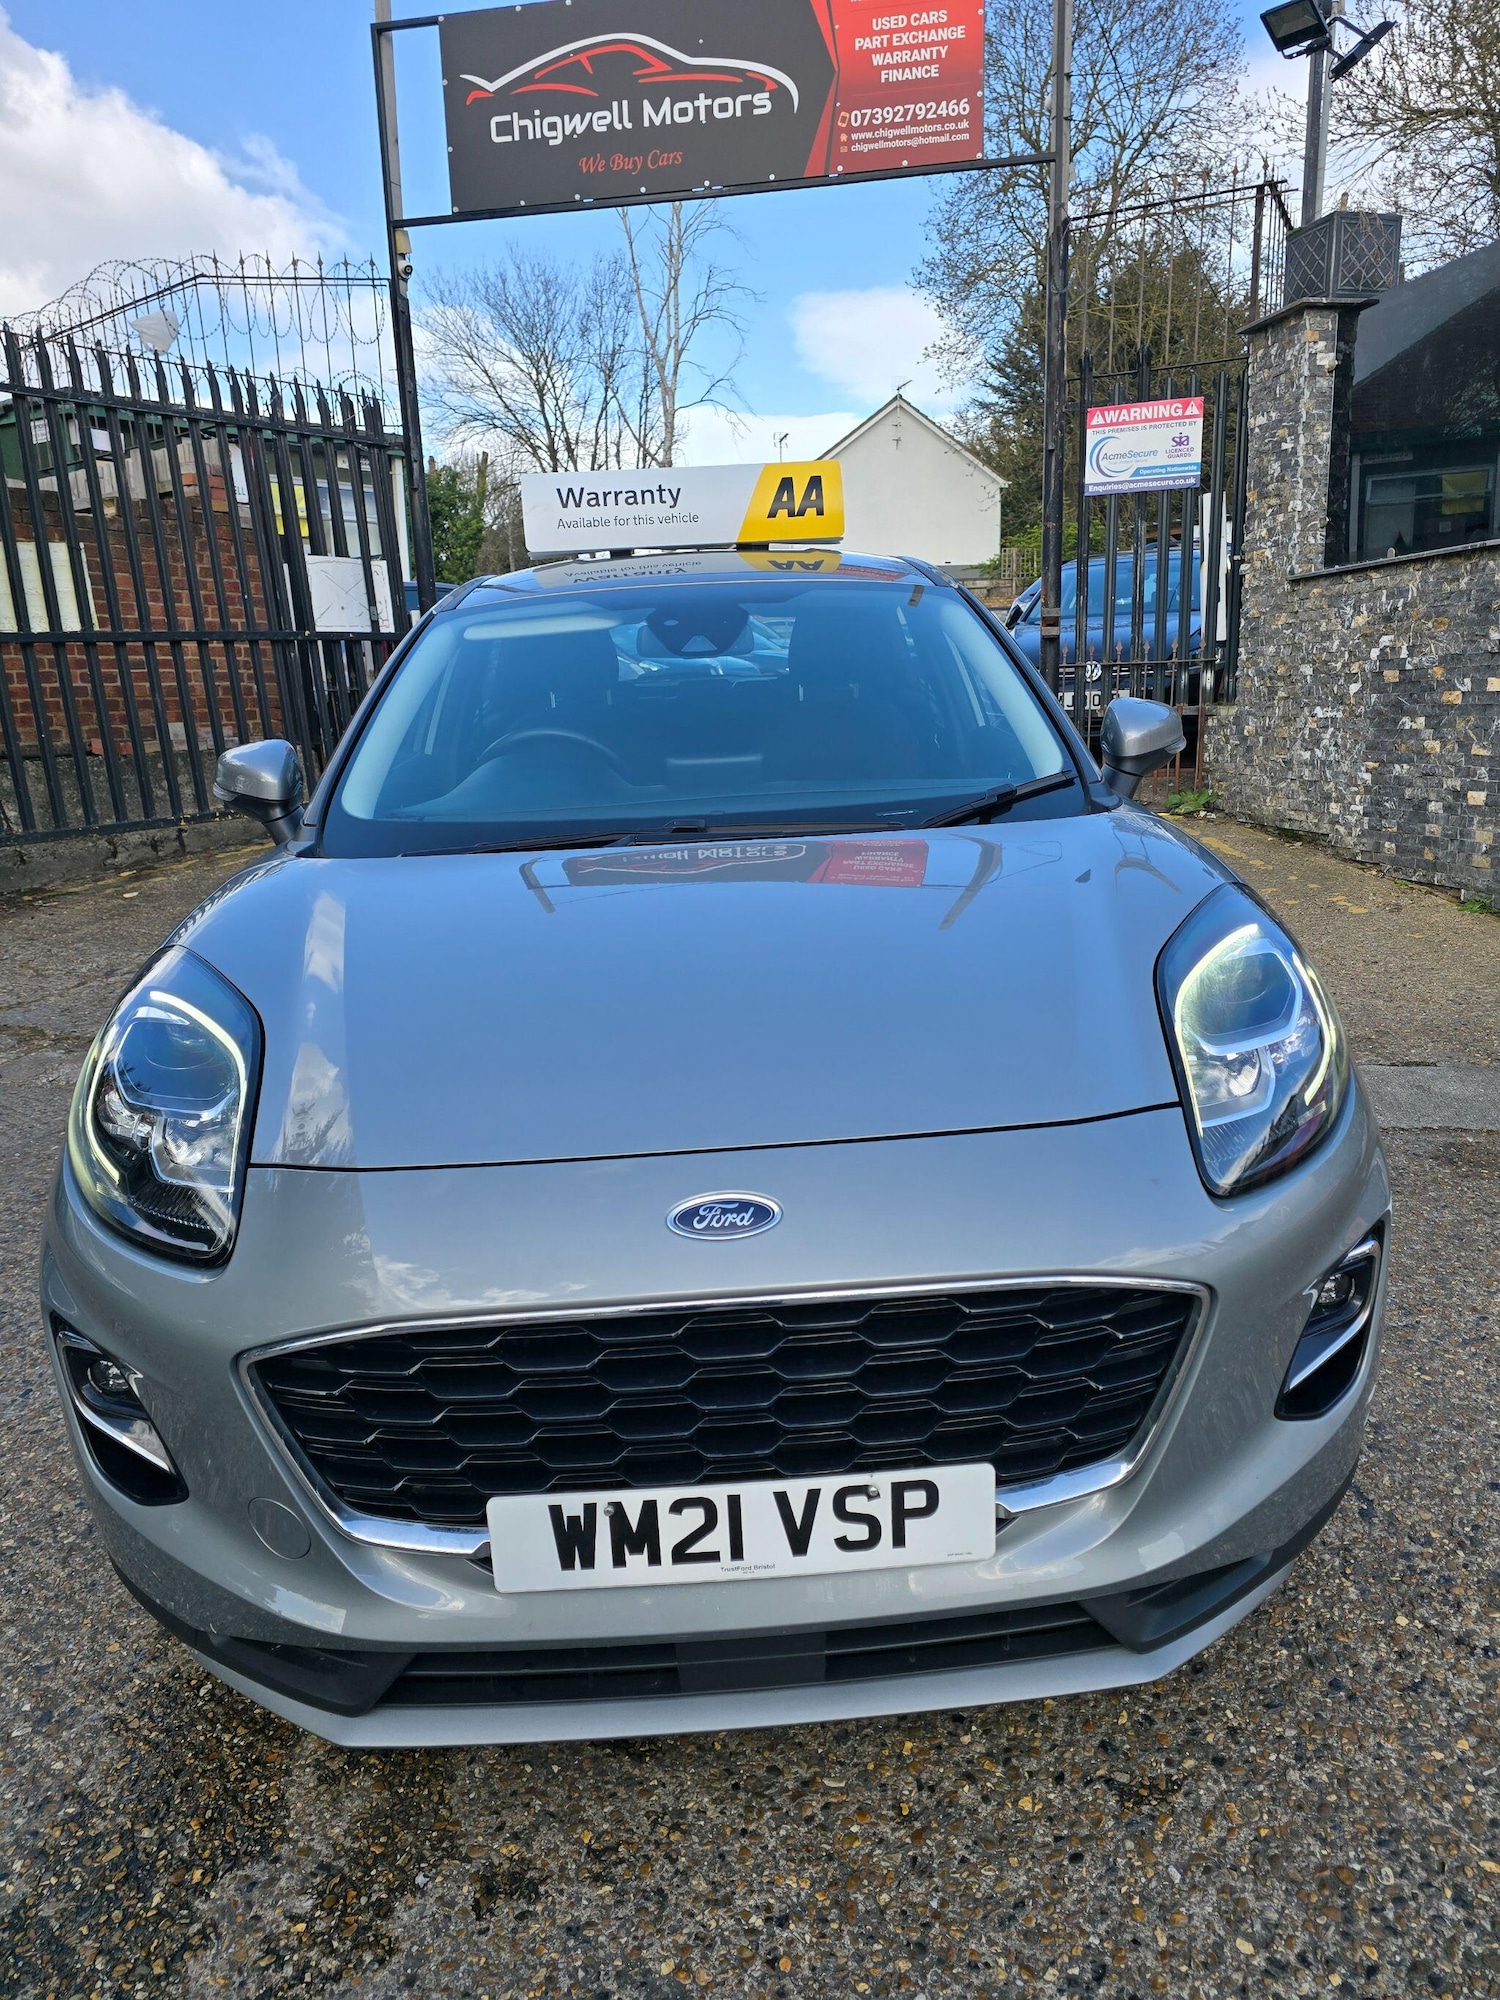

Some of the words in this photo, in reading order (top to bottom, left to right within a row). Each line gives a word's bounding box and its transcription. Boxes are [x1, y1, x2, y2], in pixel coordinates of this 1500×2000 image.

[872, 13, 907, 30] USED
[910, 9, 947, 26] CARS
[855, 34, 890, 51] PART
[892, 25, 966, 46] EXCHANGE
[871, 45, 949, 66] WARRANTY
[881, 64, 939, 83] FINANCE
[490, 99, 632, 146] Chigwell
[642, 91, 772, 127] Motors
[850, 98, 970, 127] 07392792466
[851, 119, 970, 141] www.chigwellmotors.co.uk
[851, 132, 970, 153] chigwellmotors@hotmail.com
[578, 154, 605, 175] We
[609, 152, 642, 174] Buy
[645, 149, 683, 169] Cars
[1104, 402, 1183, 423] WARNING
[1108, 426, 1140, 435] PREMISES
[1148, 421, 1187, 431] PROTECTED
[1101, 448, 1158, 462] AcmeSecure
[1165, 446, 1195, 455] LICENCED
[1139, 467, 1166, 476] Operating
[1167, 464, 1198, 473] Nationwide
[1088, 476, 1196, 492] Enquiries@acmesecure.co.uk
[556, 483, 682, 509] Warranty
[767, 475, 824, 519] AA
[557, 515, 611, 530] Available
[613, 515, 630, 527] for
[632, 513, 654, 526] this
[657, 512, 700, 525] vehicle
[693, 1202, 755, 1230] Ford
[548, 1494, 744, 1572] WM21
[772, 1478, 940, 1558] VSP
[720, 1565, 752, 1573] TrustFord
